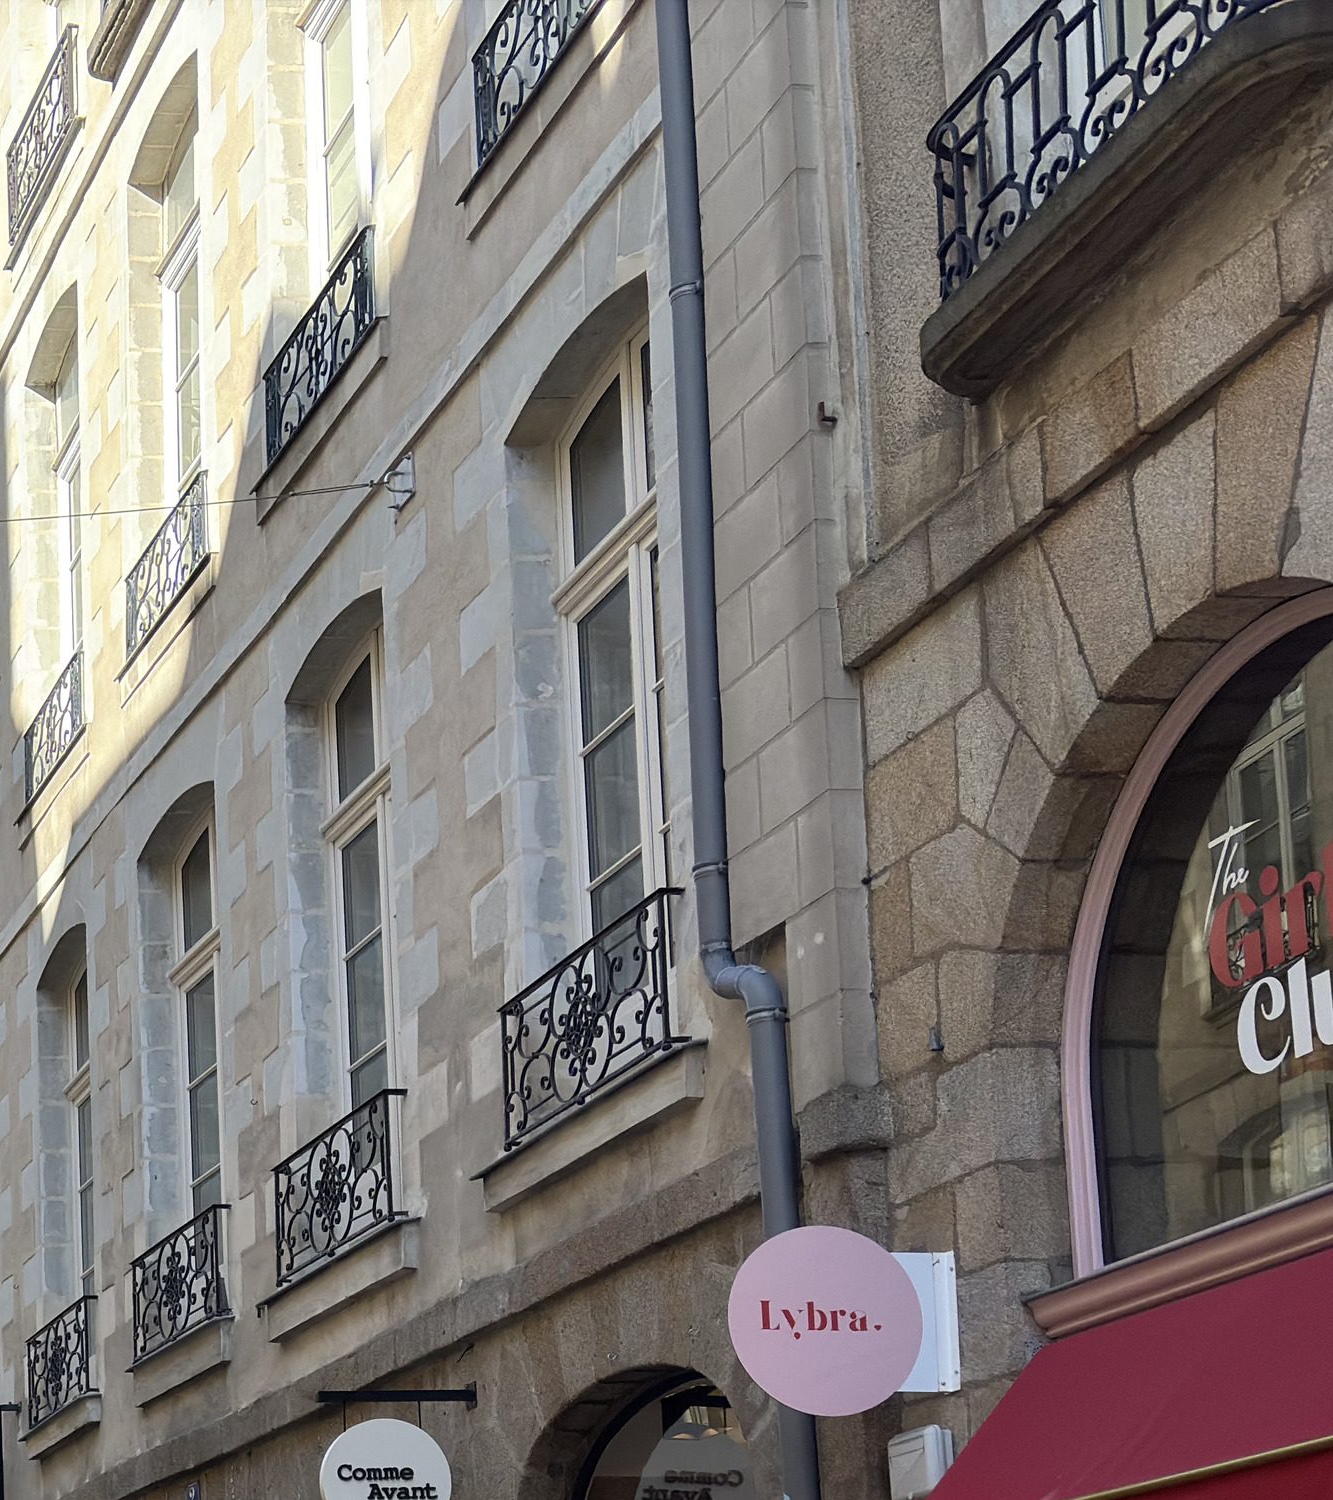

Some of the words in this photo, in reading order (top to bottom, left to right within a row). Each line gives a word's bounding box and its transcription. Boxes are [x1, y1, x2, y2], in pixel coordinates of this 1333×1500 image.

[1203, 818, 1261, 941] The
[337, 1464, 414, 1482] Comme
[367, 1483, 438, 1500] Avant
